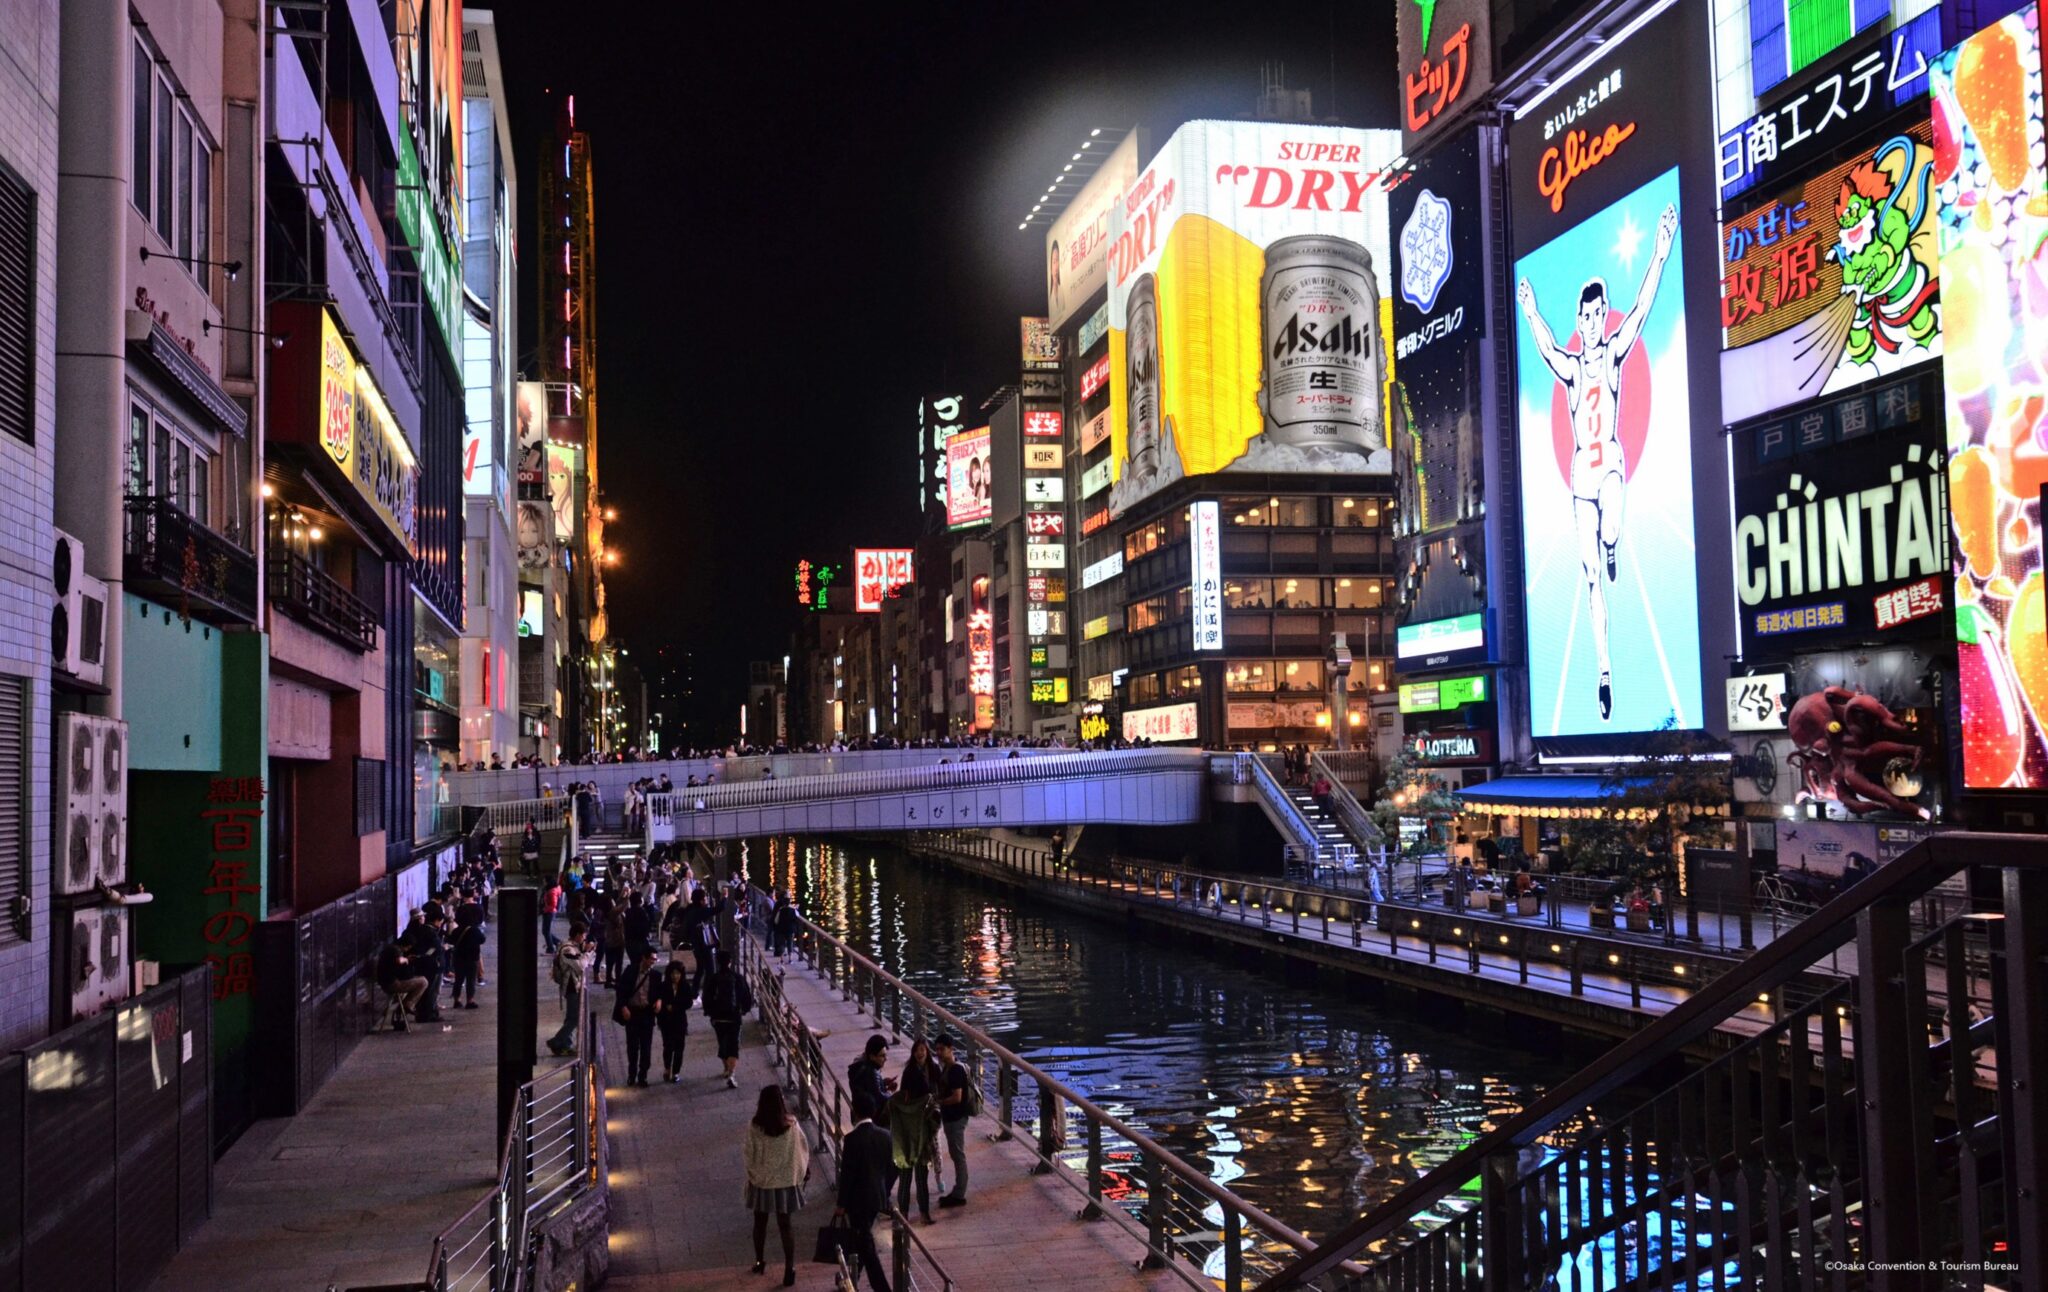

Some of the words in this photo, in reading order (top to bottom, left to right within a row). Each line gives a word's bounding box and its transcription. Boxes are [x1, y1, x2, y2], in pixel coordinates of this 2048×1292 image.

[1406, 23, 1470, 131] ピップ
[1544, 69, 1622, 140] おいしさと健康
[1720, 35, 1928, 187] 日商エステム
[1278, 141, 1361, 163] SUPER
[1538, 122, 1636, 213] Glico
[1727, 201, 1809, 262] かぜに
[1720, 233, 1820, 328] 改源
[1273, 312, 1370, 361] Asahi
[1397, 307, 1463, 359] 雪印メグミルク
[1310, 371, 1338, 389] 生
[1313, 425, 1338, 436] 350ml
[1029, 549, 1060, 560] 白木屋
[1737, 474, 1949, 605] CHINTAI
[1875, 591, 1911, 627] 賃貸
[1910, 583, 1931, 599] 住宅
[1911, 593, 1943, 617] ニュース
[1756, 604, 1844, 634] 毎週水曜日発売
[1426, 738, 1476, 756] LOTTERIA
[200, 808, 262, 1000] 百年の鍋
